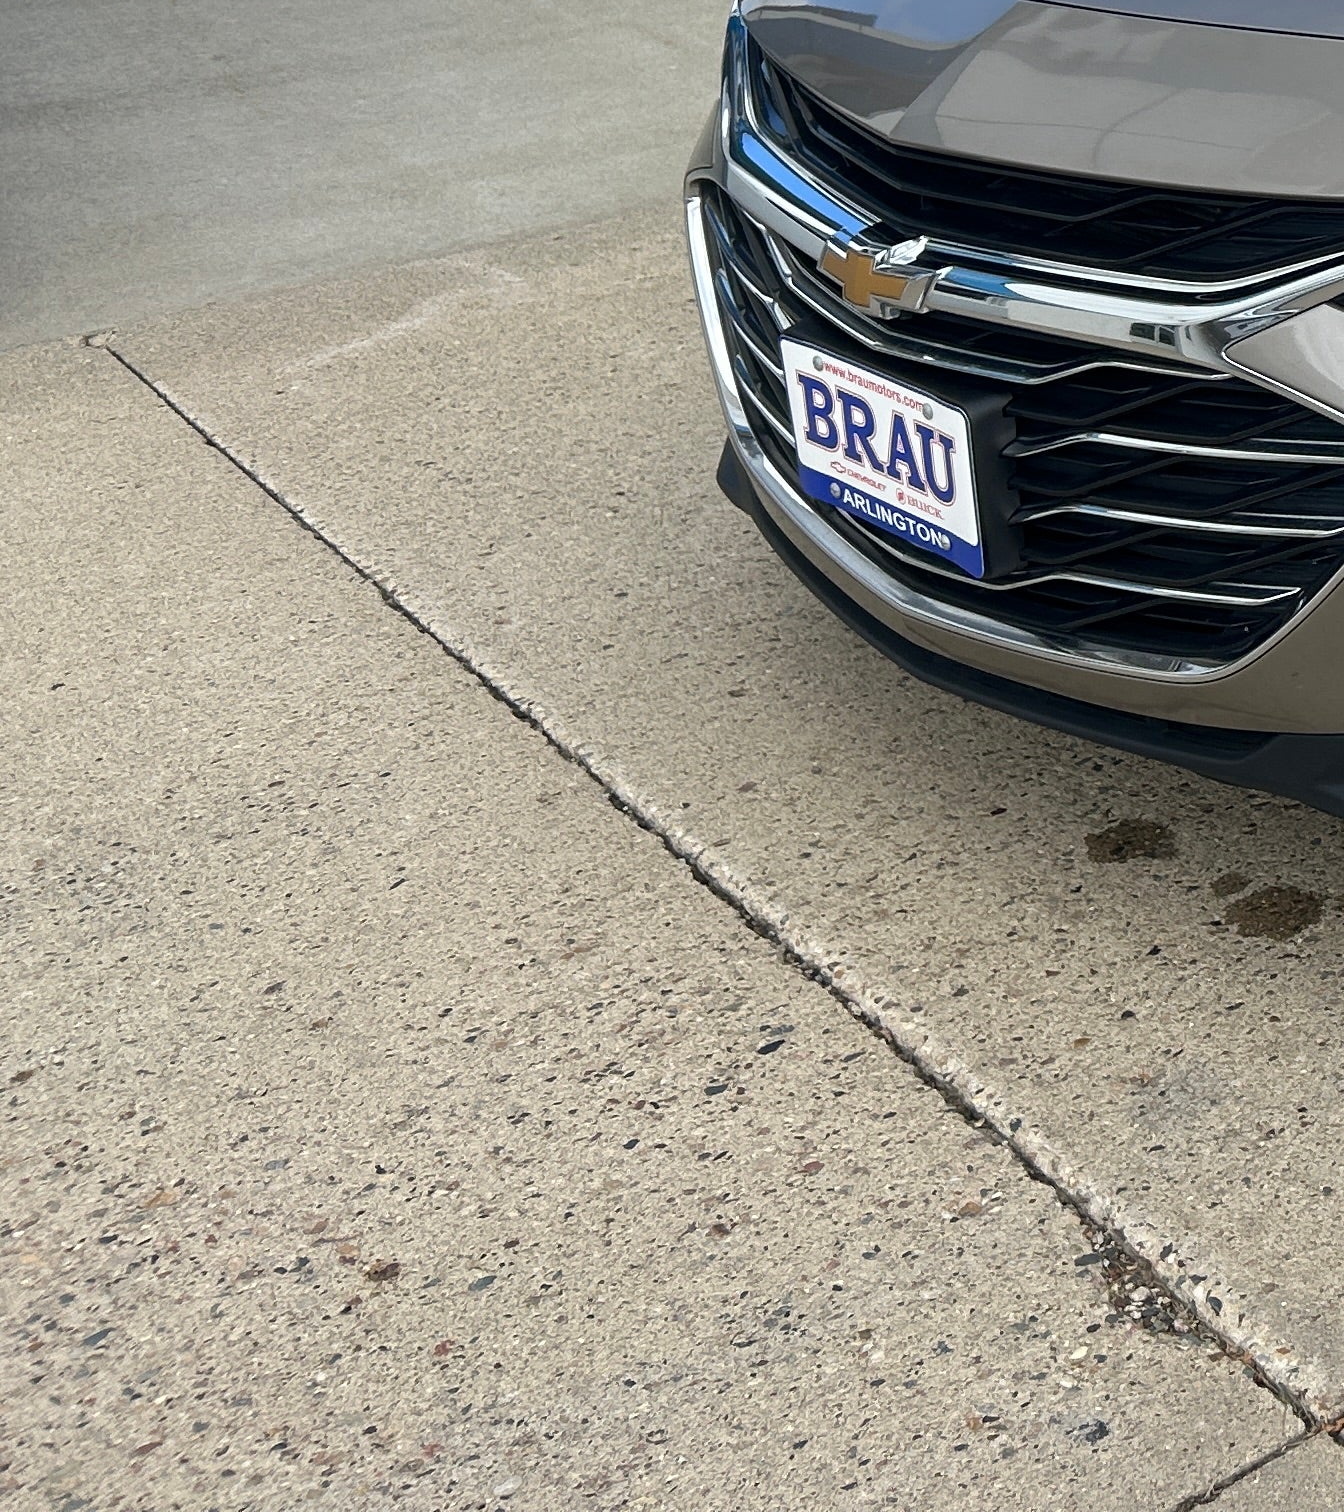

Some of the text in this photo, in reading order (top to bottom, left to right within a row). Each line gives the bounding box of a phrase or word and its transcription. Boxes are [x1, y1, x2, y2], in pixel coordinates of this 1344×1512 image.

[822, 361, 924, 413] www.braumotors.com
[795, 369, 957, 507] BRAU
[843, 488, 944, 549] ARLINGTON
[846, 468, 945, 521] CHEVROLET BUICK
